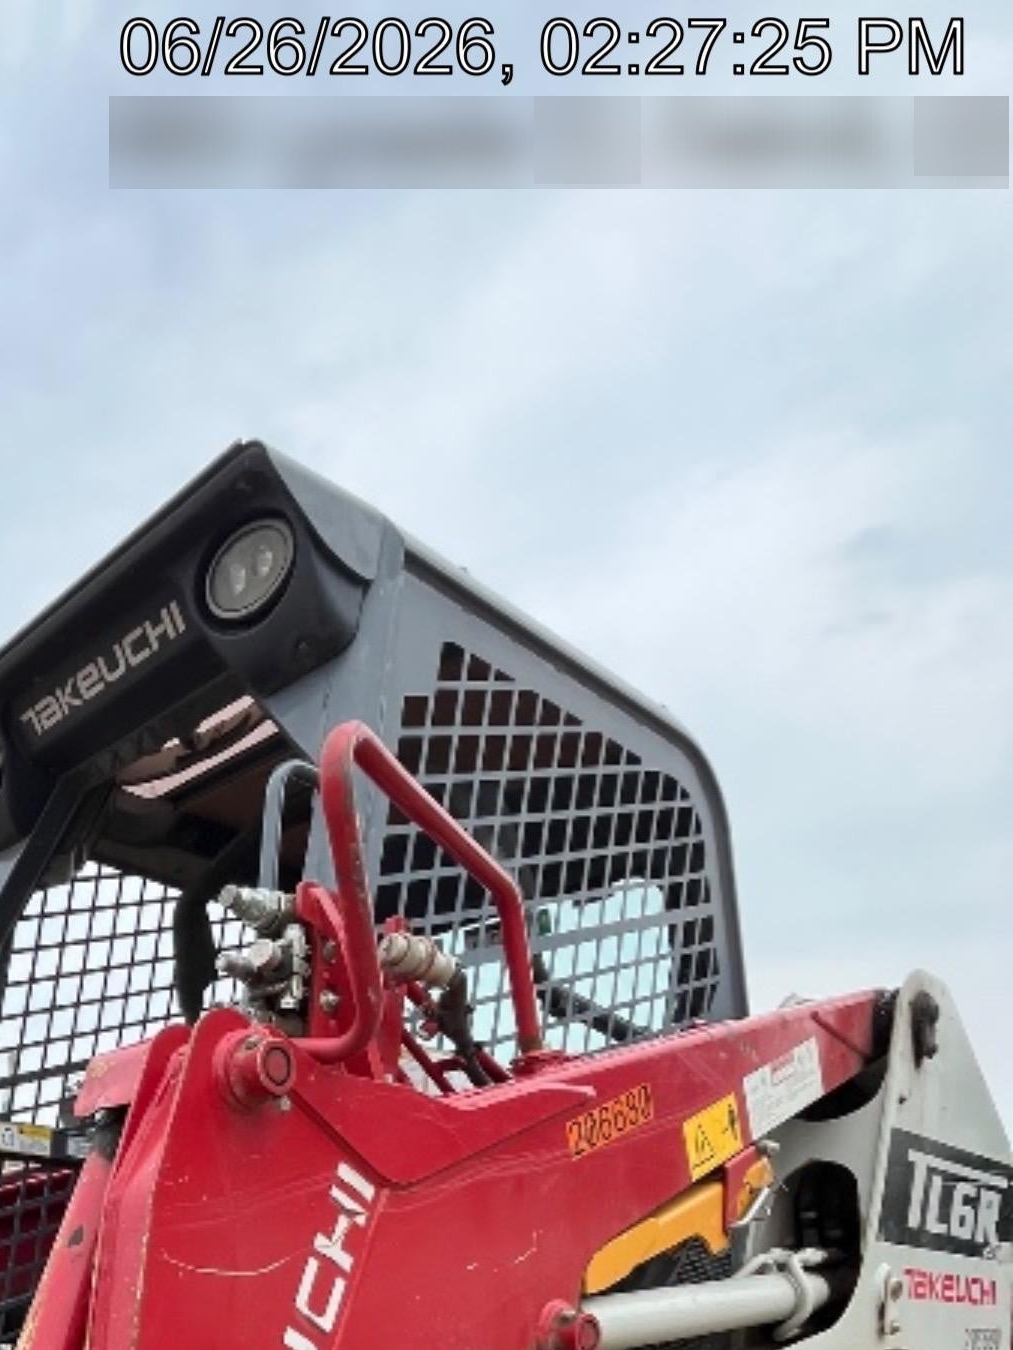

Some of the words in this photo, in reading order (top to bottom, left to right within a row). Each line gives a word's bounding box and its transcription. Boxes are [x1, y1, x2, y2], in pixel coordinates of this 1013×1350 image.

[20, 600, 186, 736] TAKEUCHI
[907, 1148, 1008, 1246] TL6R
[903, 1268, 997, 1305] TAKEUCHI
